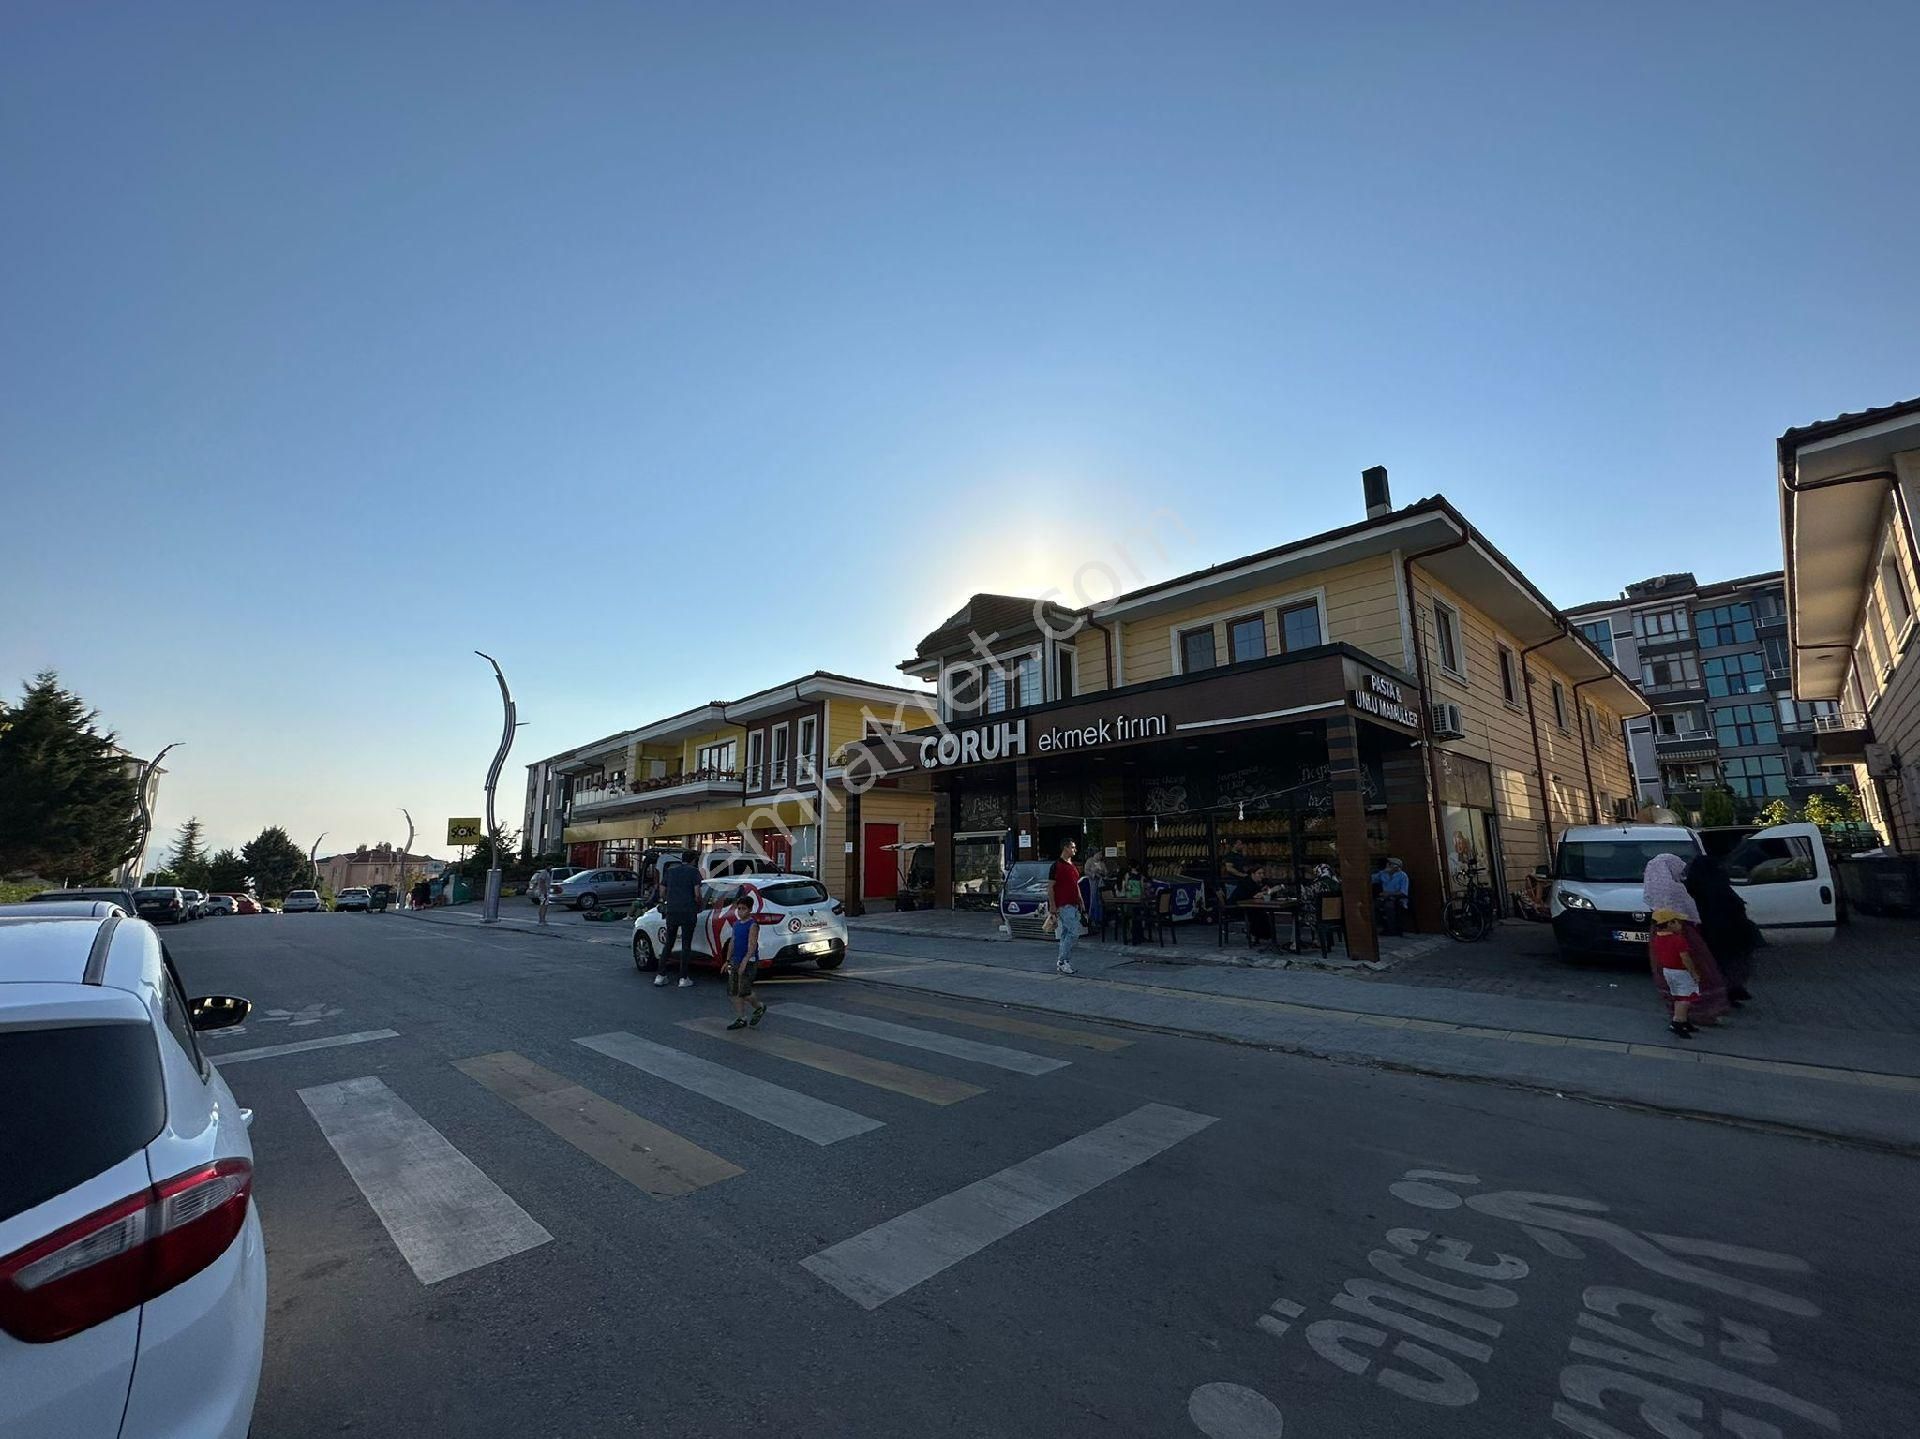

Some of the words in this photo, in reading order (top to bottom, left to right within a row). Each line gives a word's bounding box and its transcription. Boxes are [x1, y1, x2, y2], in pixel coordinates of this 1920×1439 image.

[1371, 674, 1396, 699] PASTA
[1038, 719, 1112, 751] ekmek
[1116, 714, 1167, 741] fırını
[1552, 1285, 1842, 1439] aya
